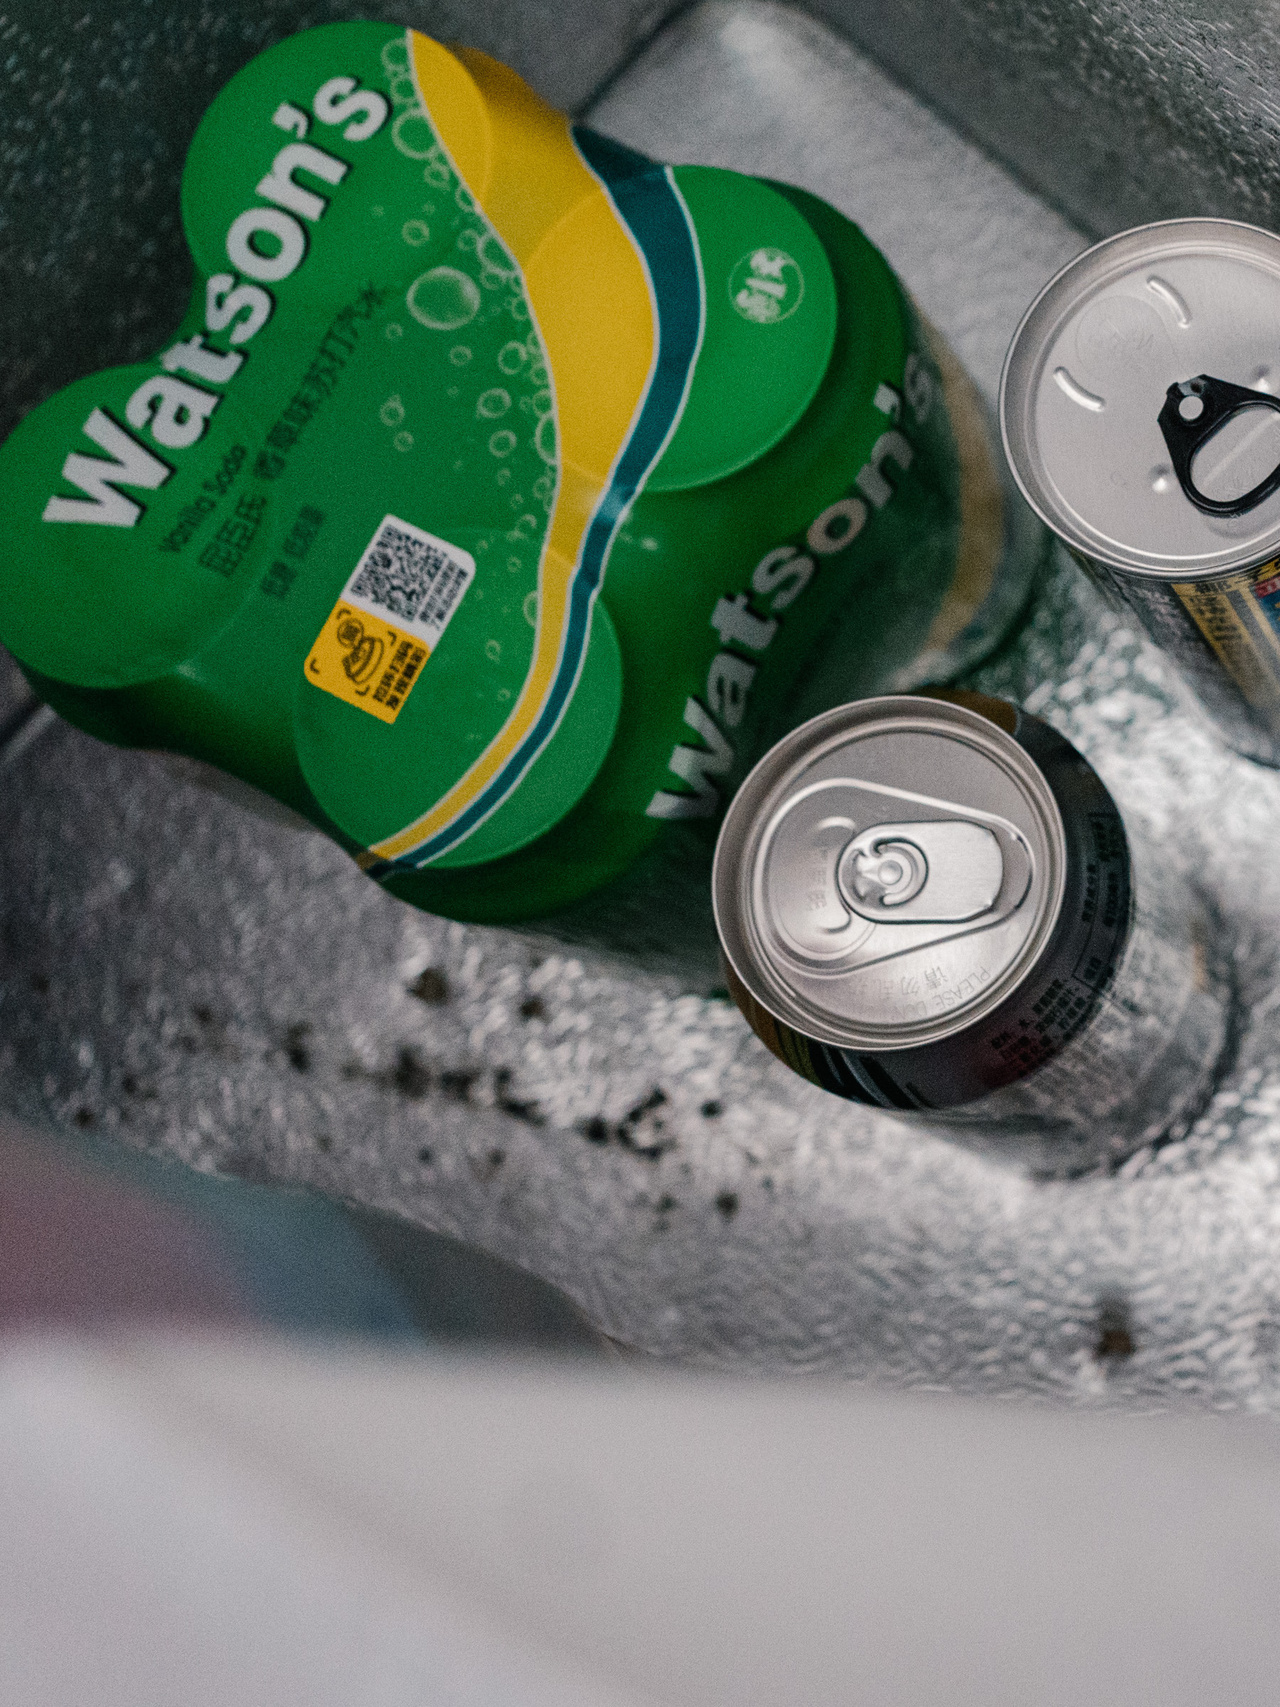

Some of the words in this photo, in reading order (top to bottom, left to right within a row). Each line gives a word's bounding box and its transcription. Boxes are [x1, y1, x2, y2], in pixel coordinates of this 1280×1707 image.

[42, 76, 390, 527] Watson's
[159, 495, 217, 552] Vanilla
[203, 443, 247, 496] Soda
[198, 497, 269, 578] 屈臣氏
[645, 353, 939, 819] Watson's
[931, 963, 993, 1011] PLEASE
